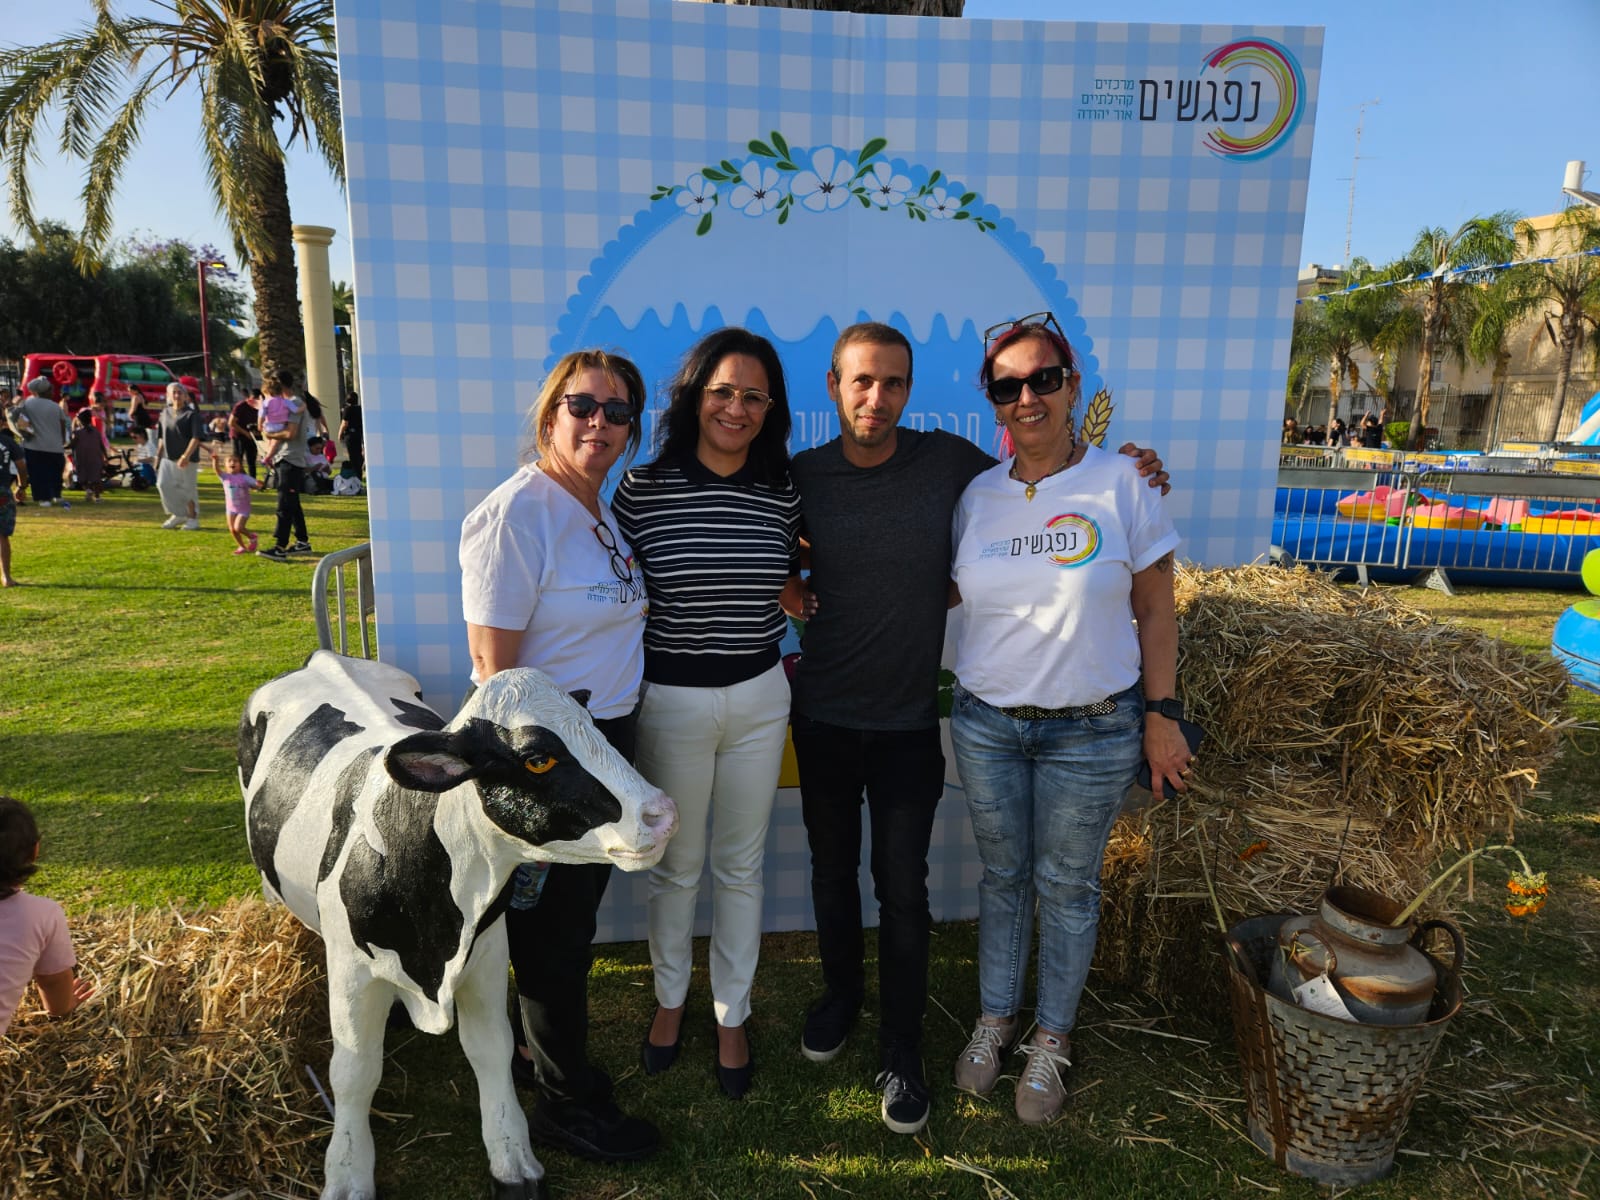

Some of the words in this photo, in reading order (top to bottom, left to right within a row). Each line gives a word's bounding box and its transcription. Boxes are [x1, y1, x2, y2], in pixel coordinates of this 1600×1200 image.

[1095, 78, 1135, 90] מרכזים
[1081, 93, 1134, 107] קהילתיים
[1139, 79, 1261, 122] נפגשים
[1077, 108, 1110, 120] יהודה
[1113, 109, 1133, 121] אור
[1010, 532, 1077, 556] נפגשים
